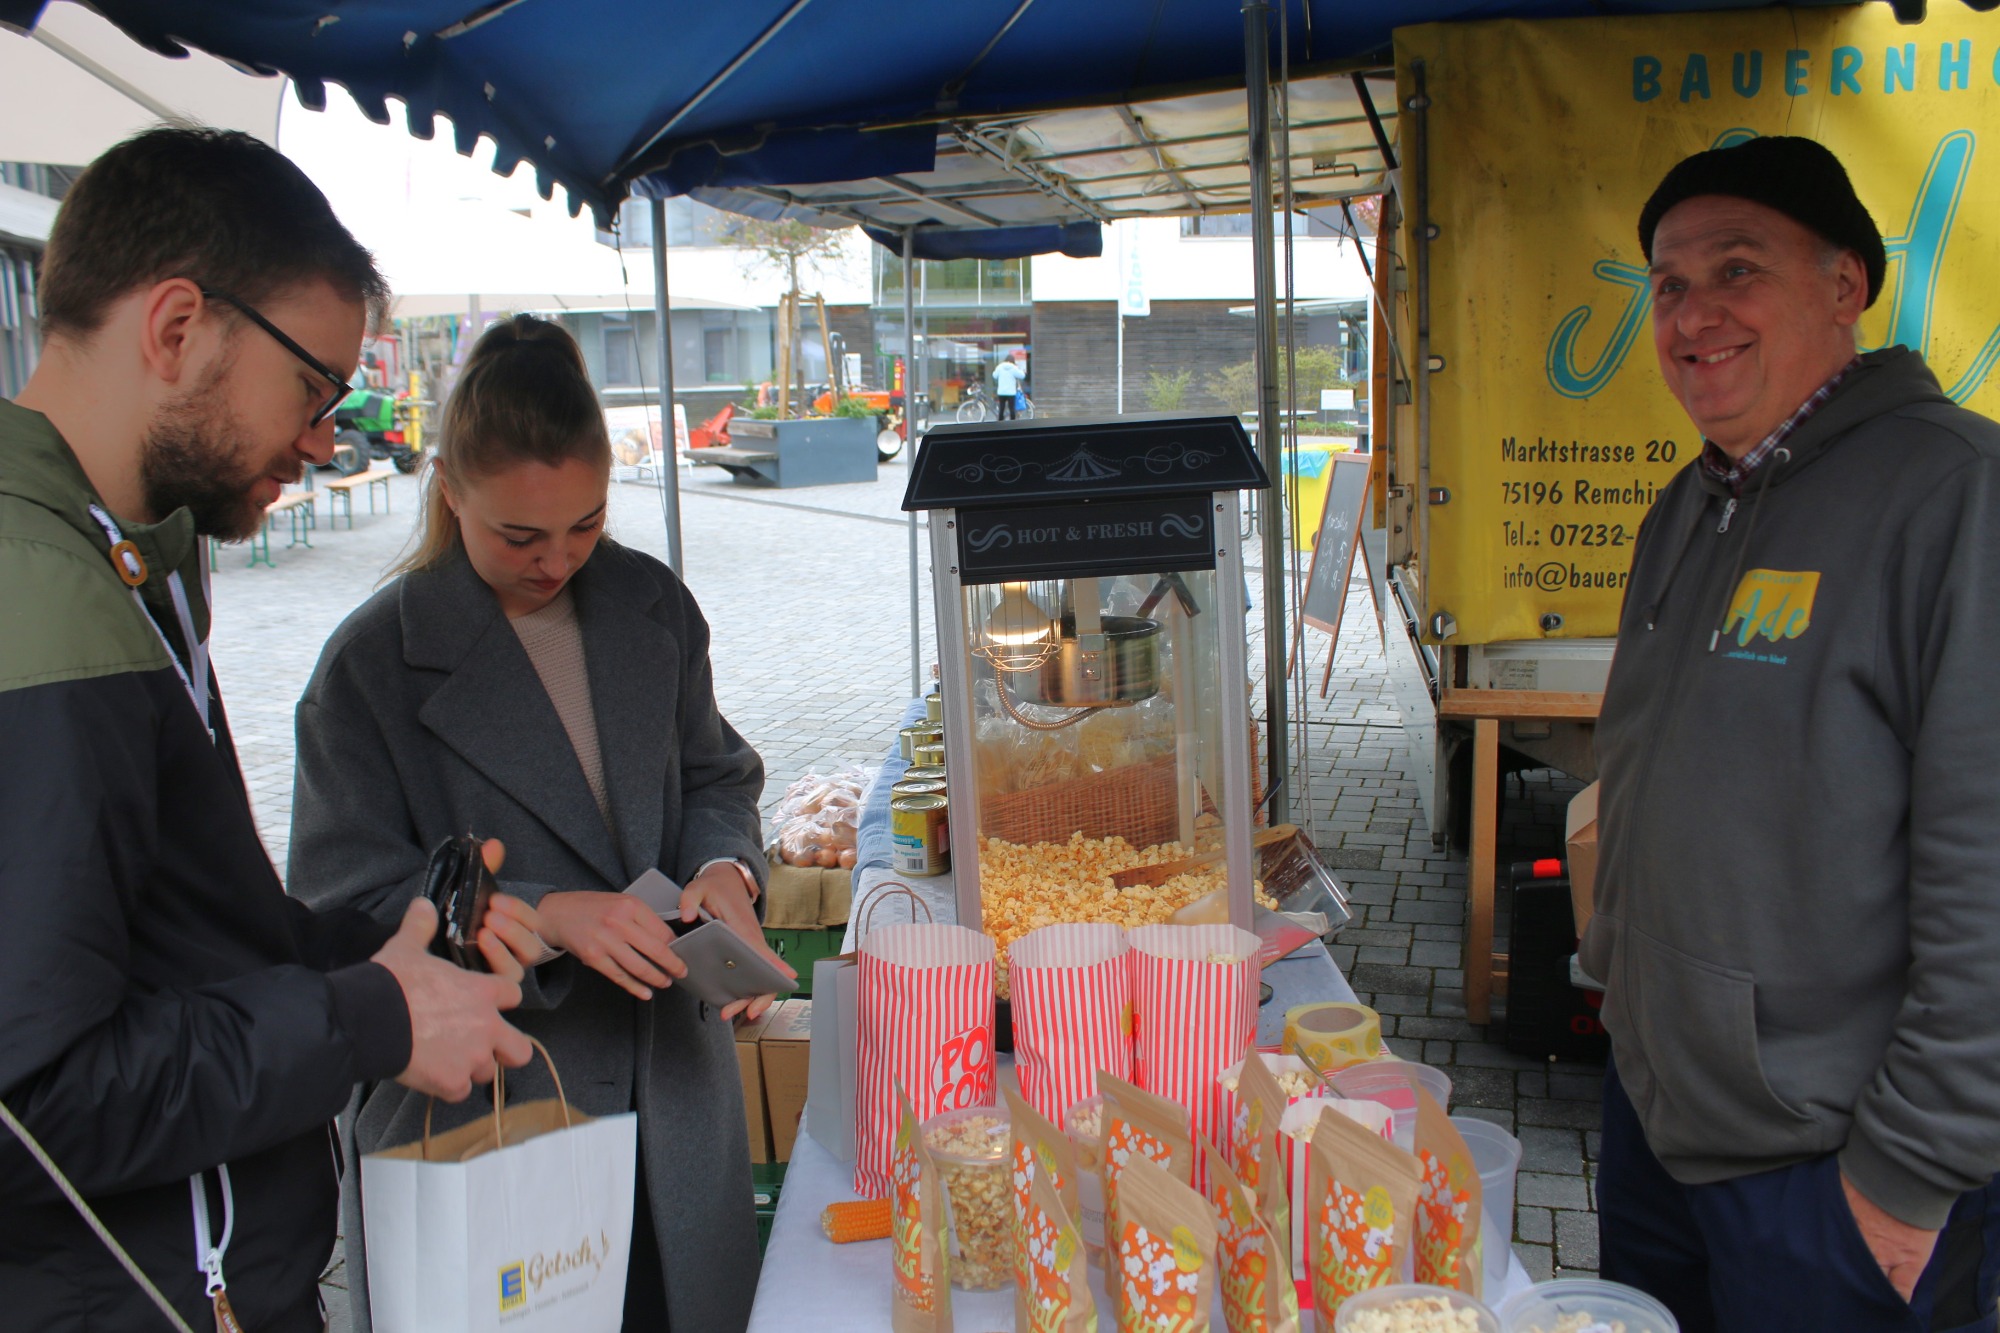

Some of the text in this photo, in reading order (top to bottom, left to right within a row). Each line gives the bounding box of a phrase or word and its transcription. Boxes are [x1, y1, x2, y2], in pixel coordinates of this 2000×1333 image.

[1501, 436, 1677, 463] Marktstrasse 20
[1501, 480, 1564, 505] 75196
[1017, 521, 1154, 545] HOT & FRESH
[1502, 520, 1541, 547] Tel.:
[1722, 587, 1806, 645] Ade
